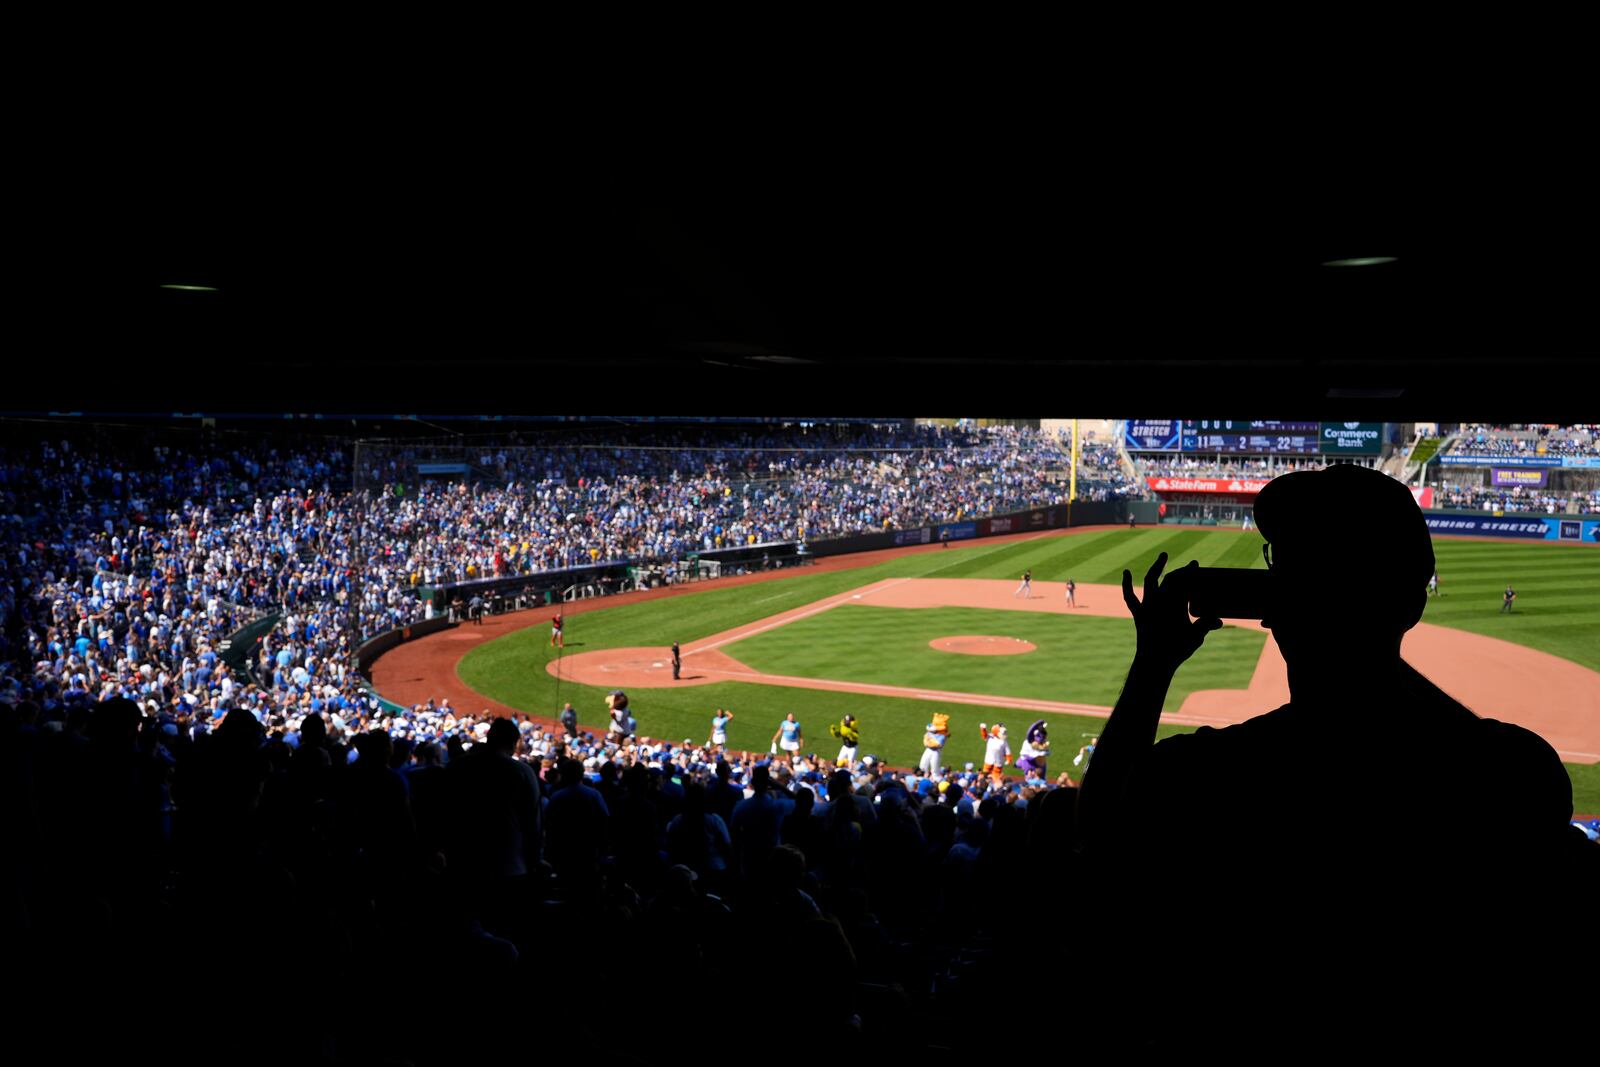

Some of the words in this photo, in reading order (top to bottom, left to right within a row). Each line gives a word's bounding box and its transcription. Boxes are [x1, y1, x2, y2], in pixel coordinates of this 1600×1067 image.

[1132, 426, 1171, 436] STRETCH
[1324, 429, 1378, 438] Commerce
[1197, 435, 1208, 448] 11
[1239, 436, 1247, 449] 2
[1277, 436, 1290, 449] 22
[1337, 437, 1363, 447] Bank
[1481, 522, 1550, 533] STRETCH
